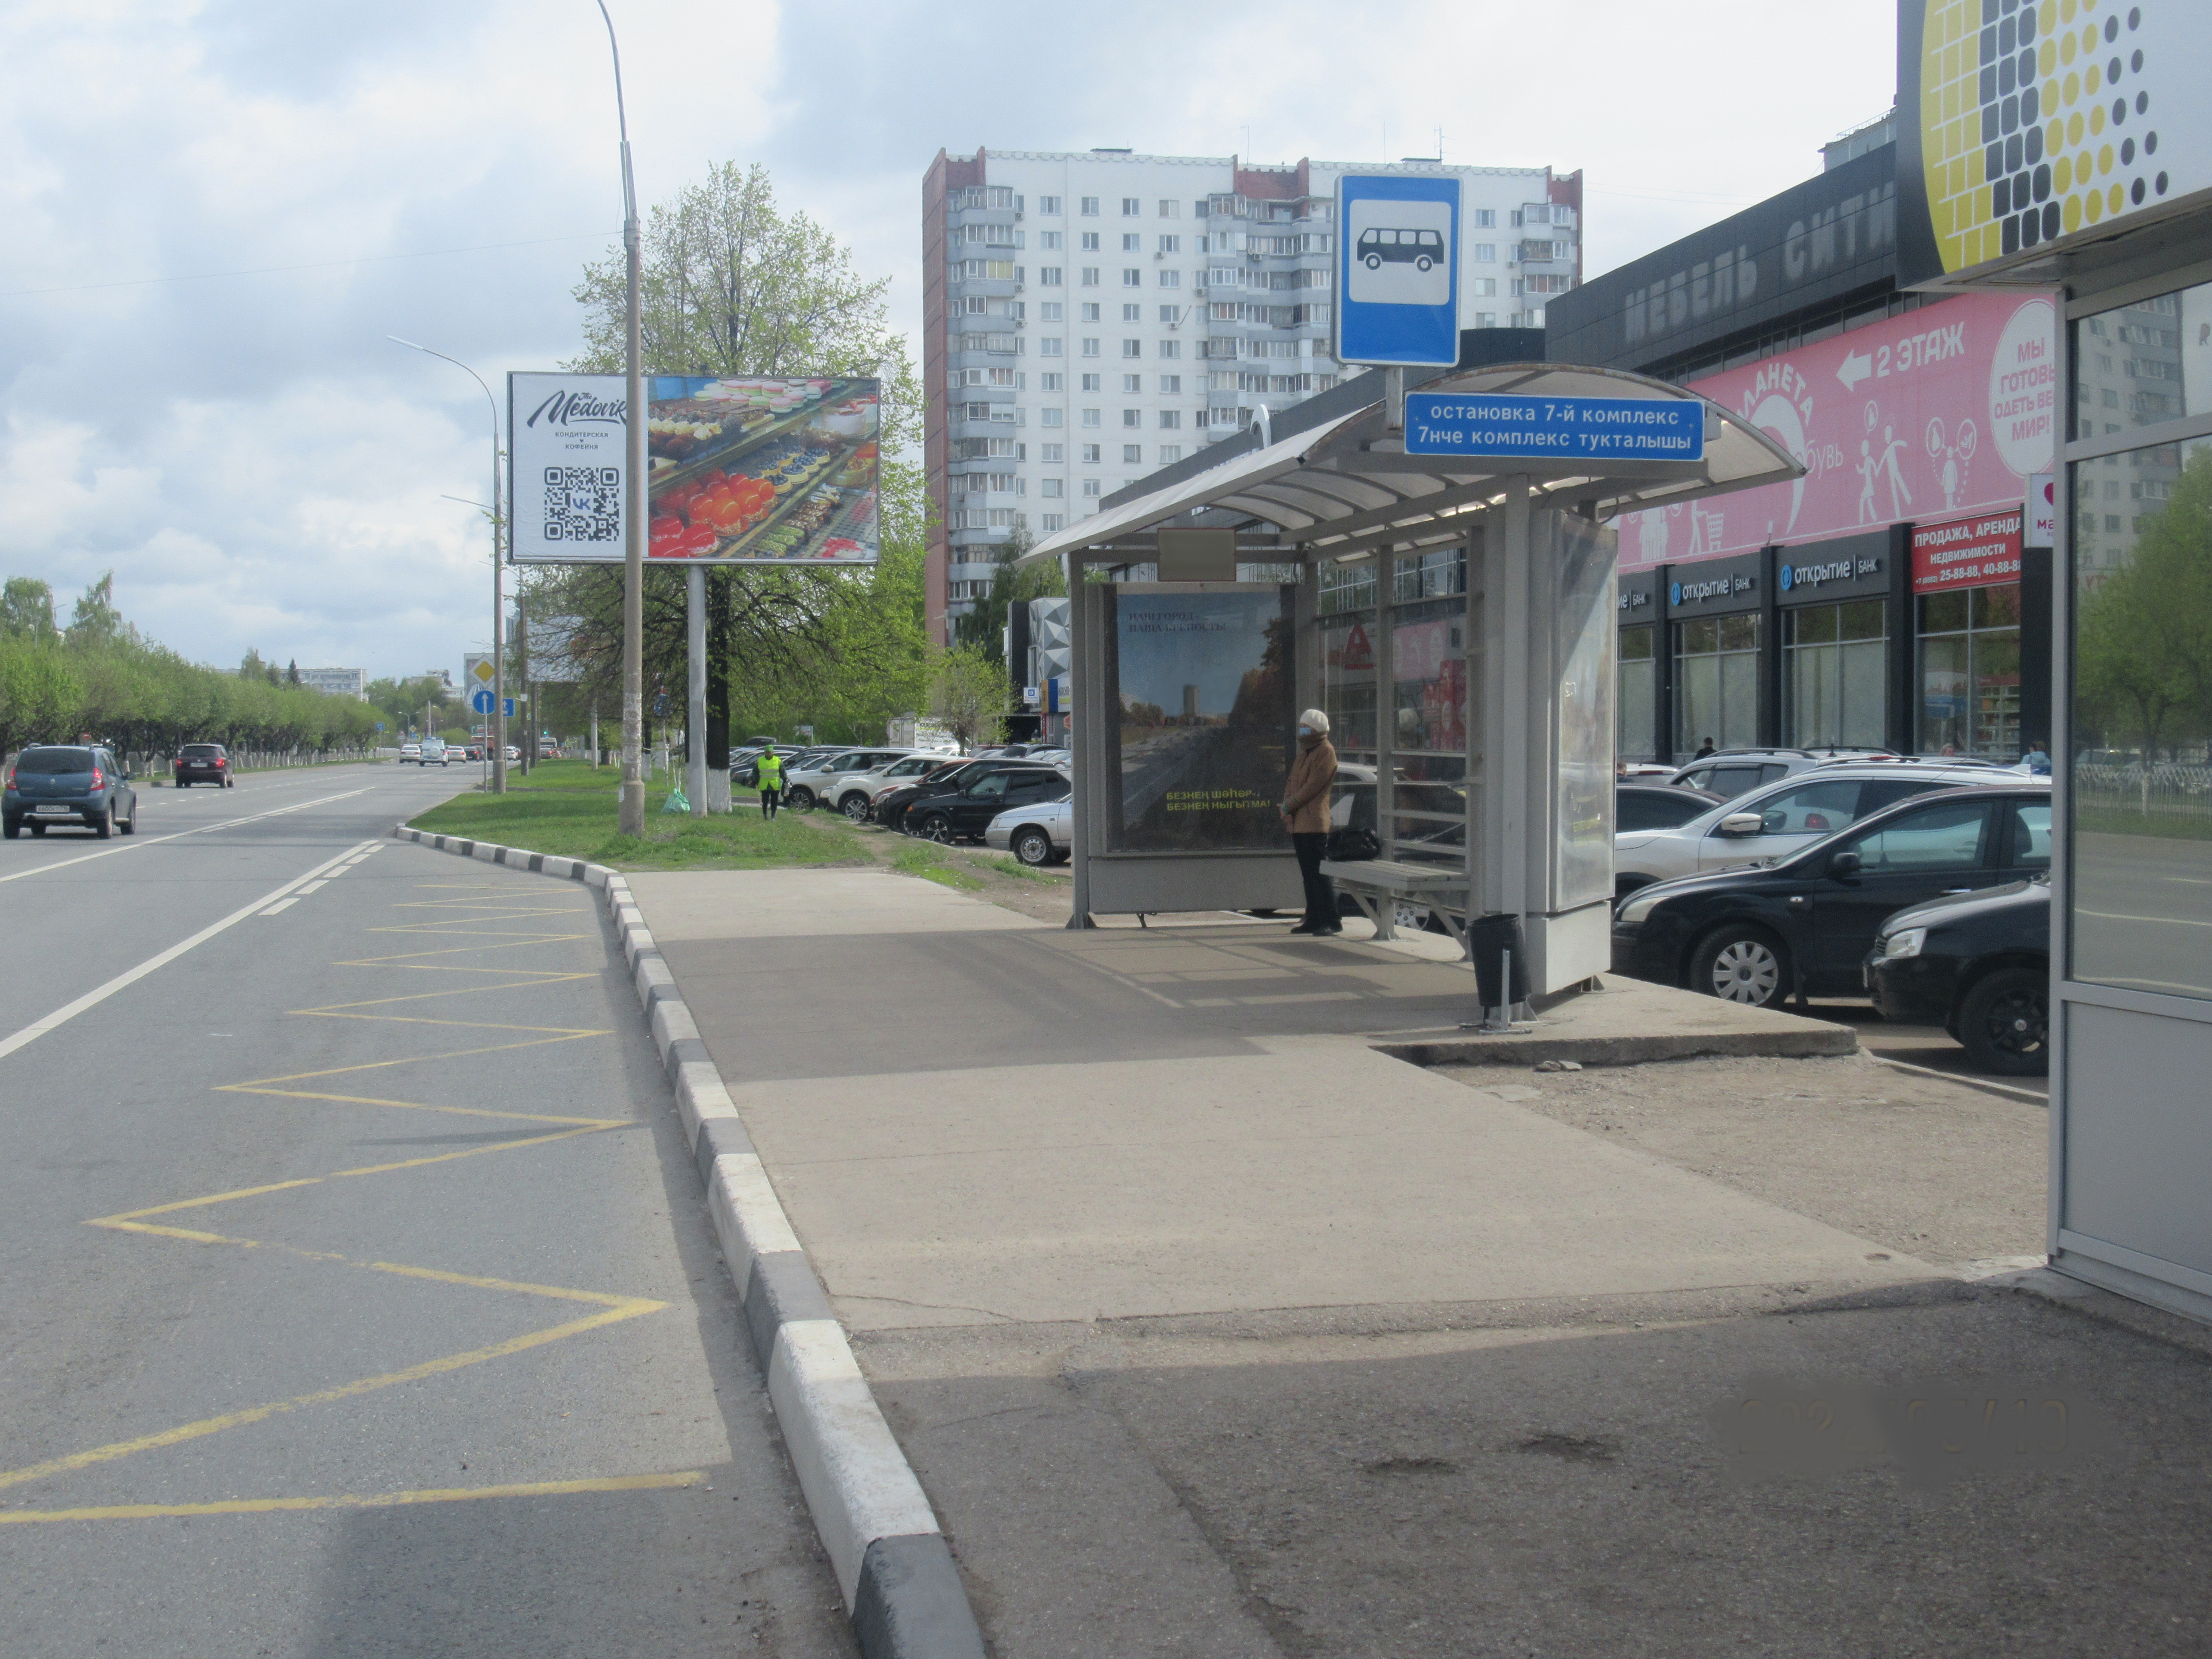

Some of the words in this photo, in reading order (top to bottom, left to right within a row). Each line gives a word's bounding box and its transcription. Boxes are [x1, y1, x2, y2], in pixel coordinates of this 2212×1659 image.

[1625, 245, 1758, 343] МЕБЕЛЬ
[1785, 180, 1895, 279] СИТИ
[1877, 346, 1890, 377] 2
[1897, 322, 1965, 371] ЭТАЖ
[2018, 337, 2045, 362] МЫ
[578, 392, 592, 401] The
[1736, 363, 1813, 427] ЛАНЕТА
[1994, 396, 2034, 419] ОДЕТЬ
[527, 390, 627, 428] Medovik
[1430, 405, 1535, 421] остановка
[1545, 405, 1575, 422] 7-й
[1583, 410, 1679, 425] комплекс
[1418, 427, 1463, 444] 7нче
[1472, 429, 1570, 446] комплекс
[1580, 433, 1691, 451] тукталышы
[2012, 414, 2051, 441] МИР!
[1915, 526, 1973, 547] ПРОДАЖА,
[1931, 543, 2006, 564] НЕДВИЖИМОСТИ
[1795, 561, 1850, 587] открытие
[1858, 559, 1877, 573] БАНК
[1633, 594, 1646, 605] БАНК
[1683, 579, 1728, 602] открытие
[1735, 577, 1751, 591] БАНК
